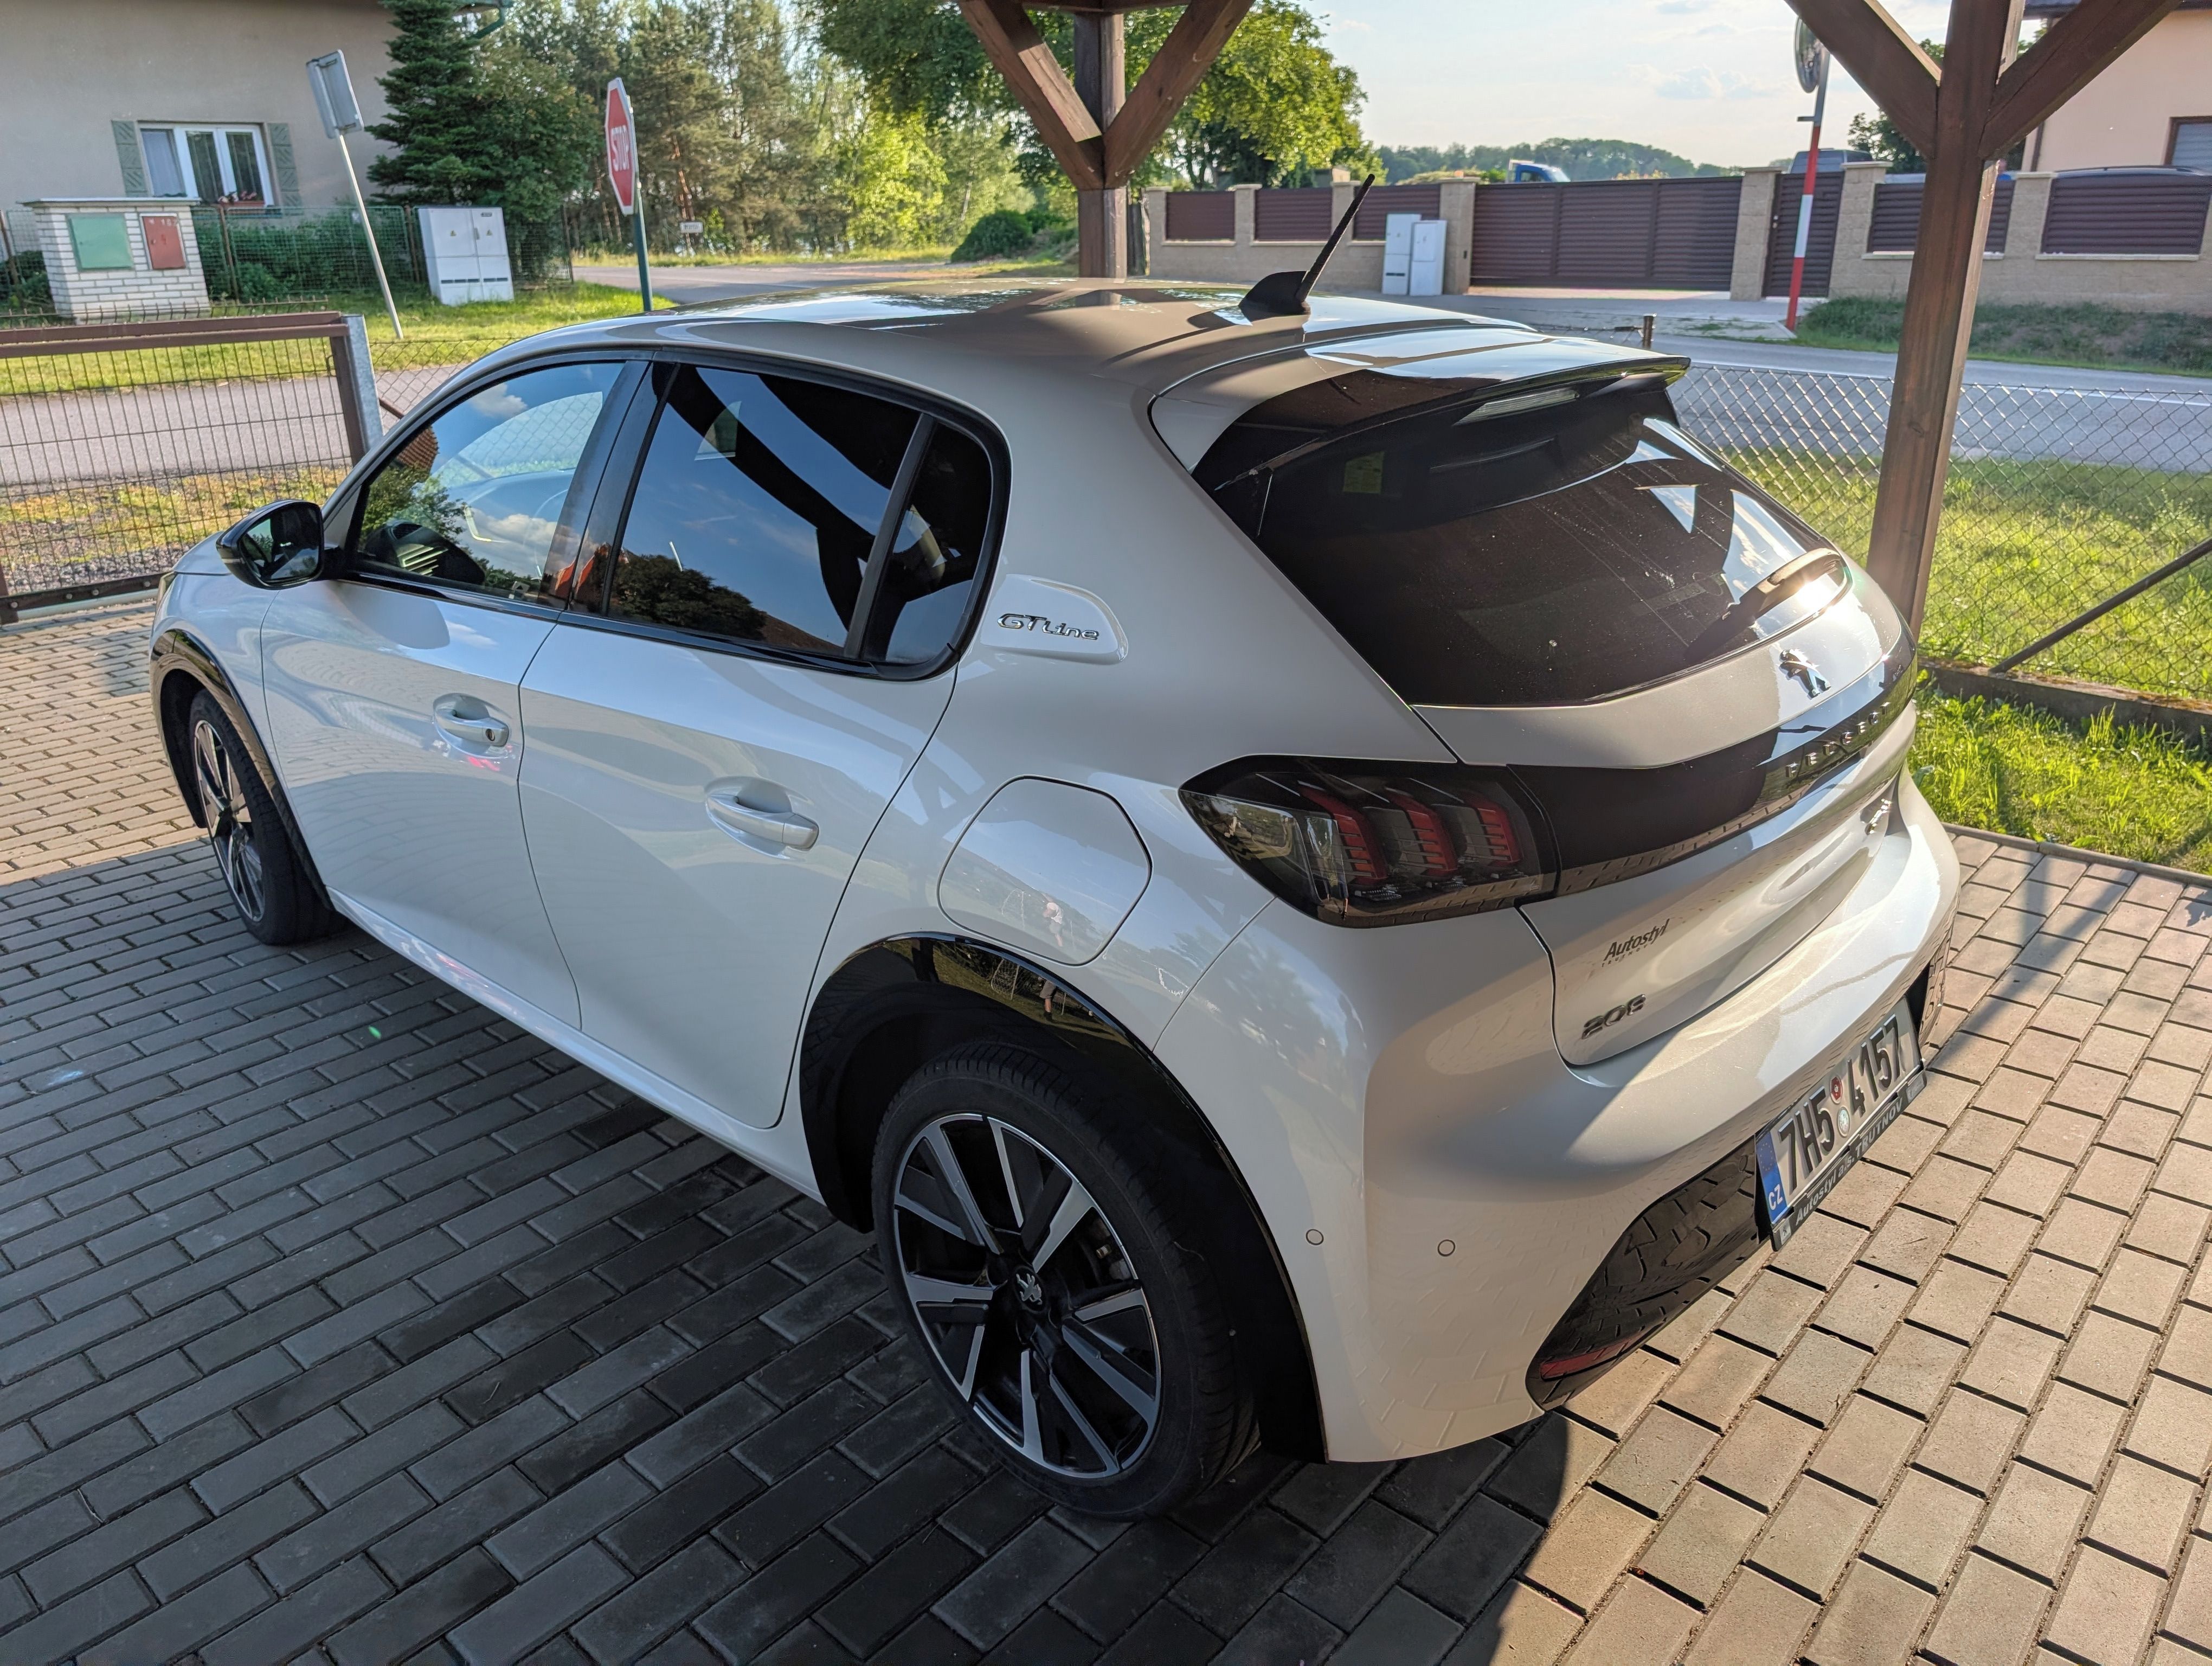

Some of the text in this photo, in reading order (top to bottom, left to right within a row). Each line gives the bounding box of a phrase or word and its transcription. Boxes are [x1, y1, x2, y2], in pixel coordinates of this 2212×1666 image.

[611, 125, 629, 171] STOP
[1785, 702, 1891, 778] PEUGEOT
[1603, 918, 1670, 962] Autostyl
[1581, 994, 1647, 1040] 208
[1778, 1014, 1900, 1194] 7H5 4157
[1795, 1097, 1903, 1226] Autostyl a.s. TRUTNOV
[1768, 1184, 1783, 1210] CZ
